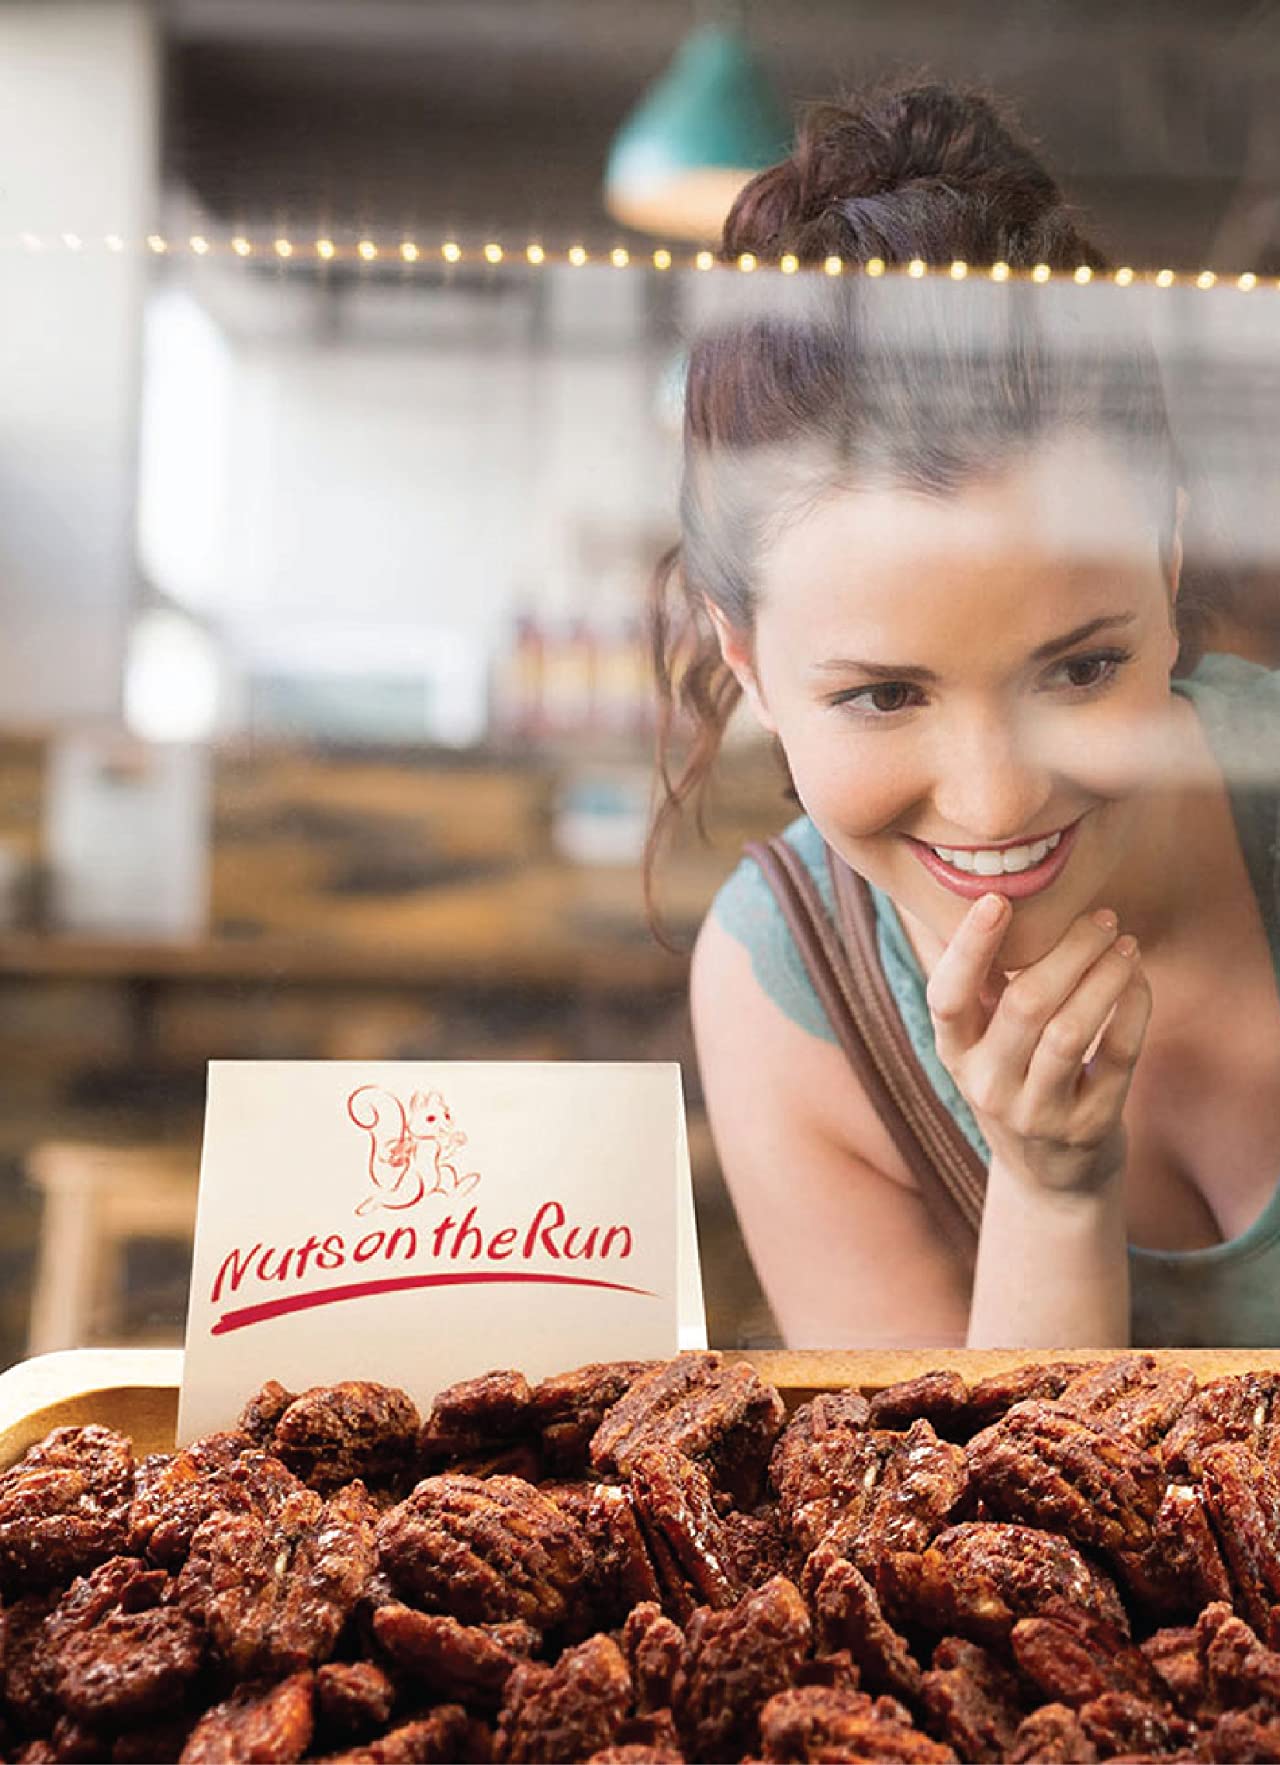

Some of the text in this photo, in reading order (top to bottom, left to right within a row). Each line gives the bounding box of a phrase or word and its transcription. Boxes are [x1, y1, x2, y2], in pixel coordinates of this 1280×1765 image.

[211, 1201, 632, 1303] Nuts on the Run
